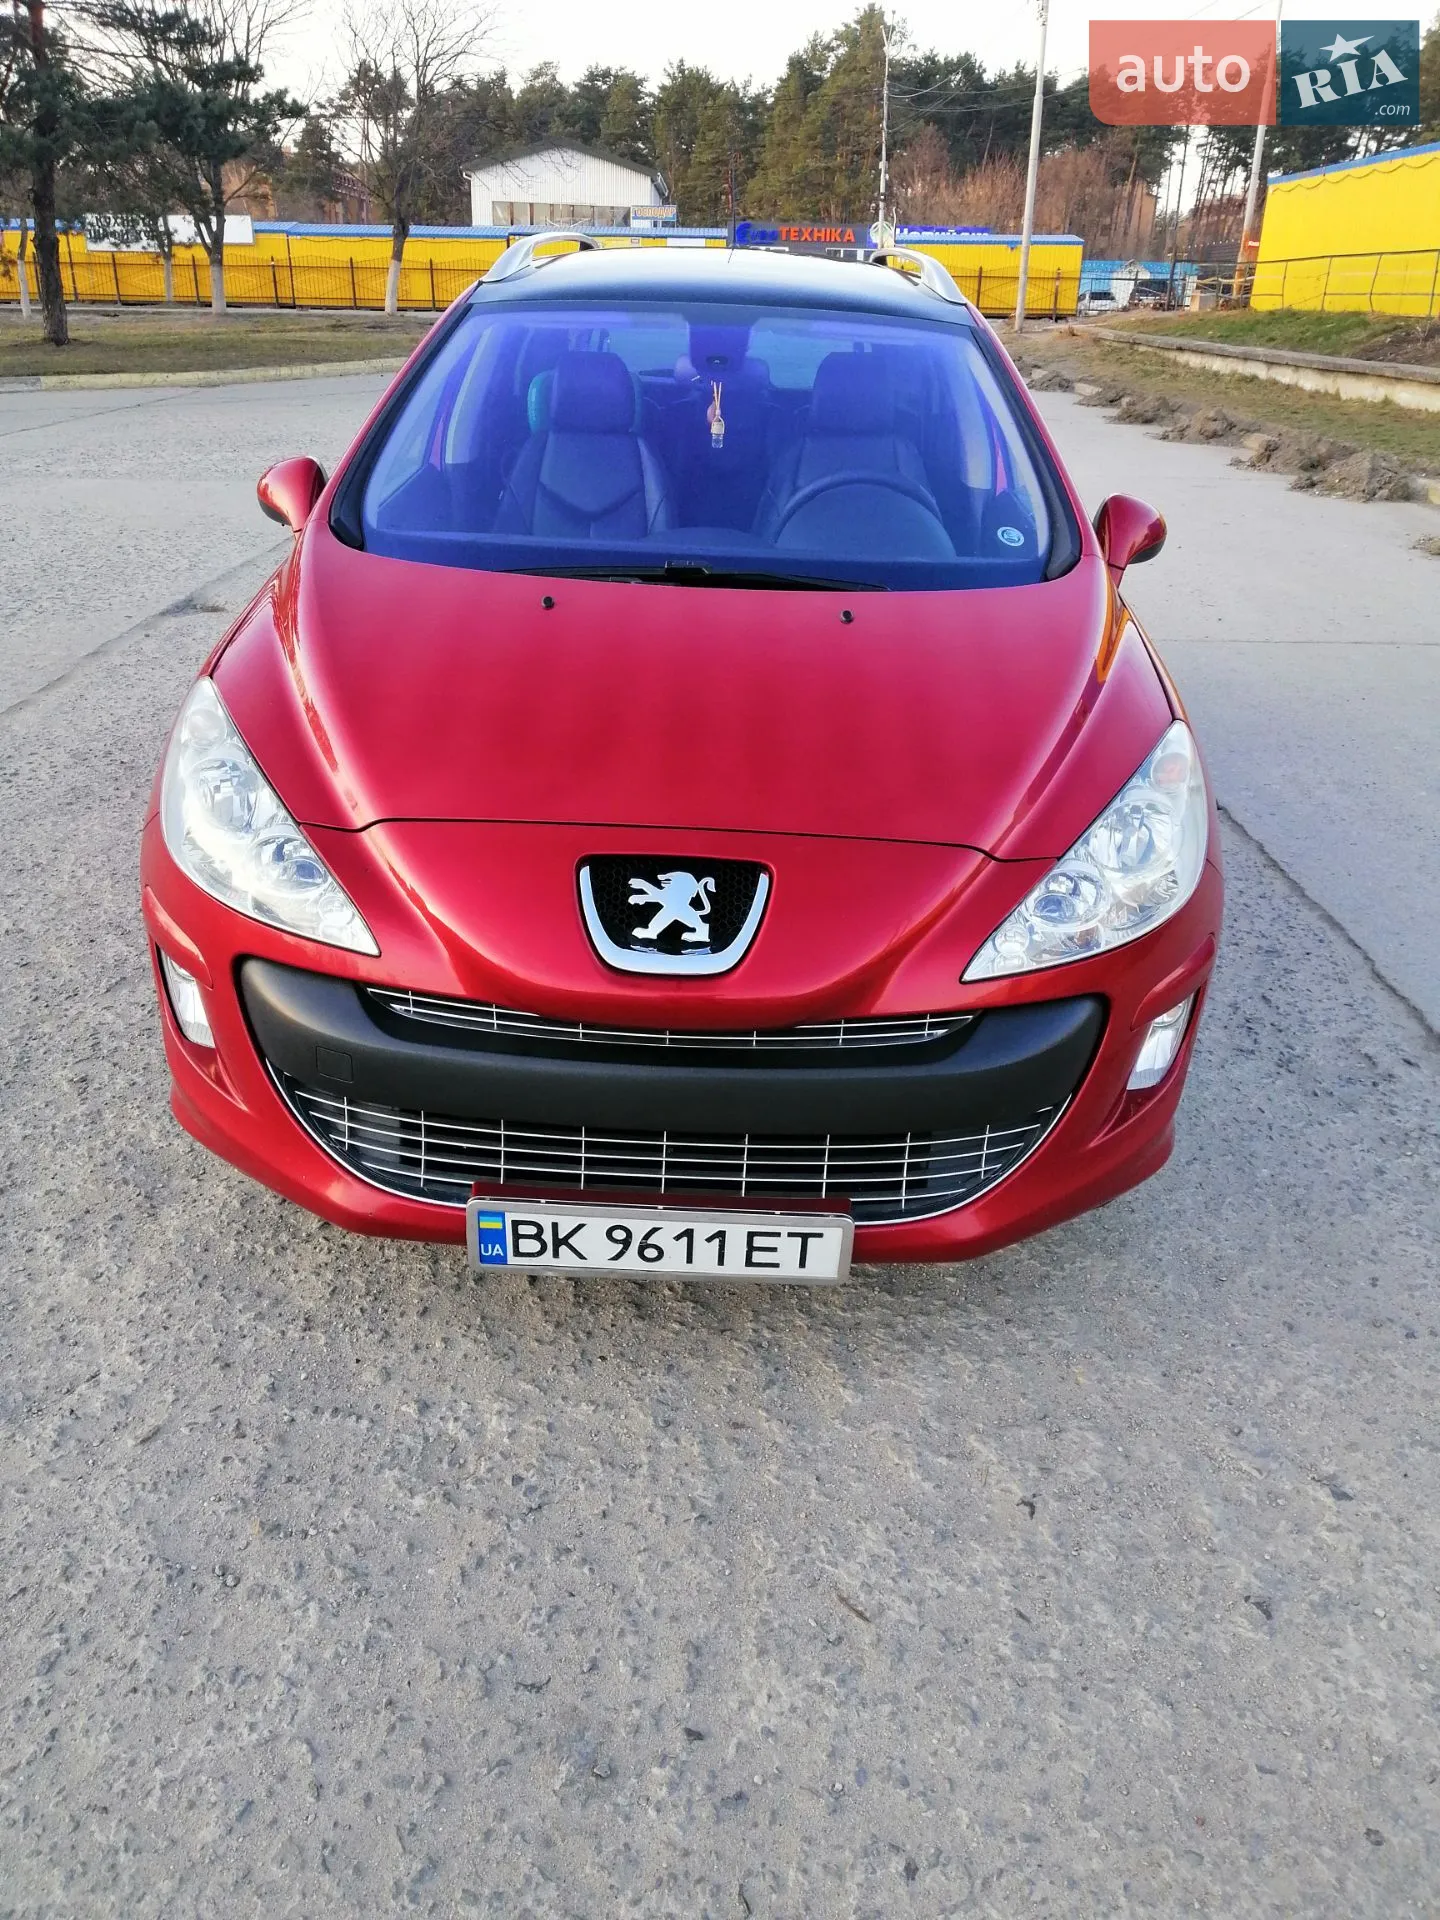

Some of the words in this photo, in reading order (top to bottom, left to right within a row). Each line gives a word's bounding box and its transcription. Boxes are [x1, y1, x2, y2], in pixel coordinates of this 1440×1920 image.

[779, 226, 856, 242] ТЕХНІКА
[480, 1243, 504, 1258] UA
[510, 1218, 588, 1261] BK
[605, 1224, 727, 1267] 9611
[744, 1230, 824, 1269] ET
